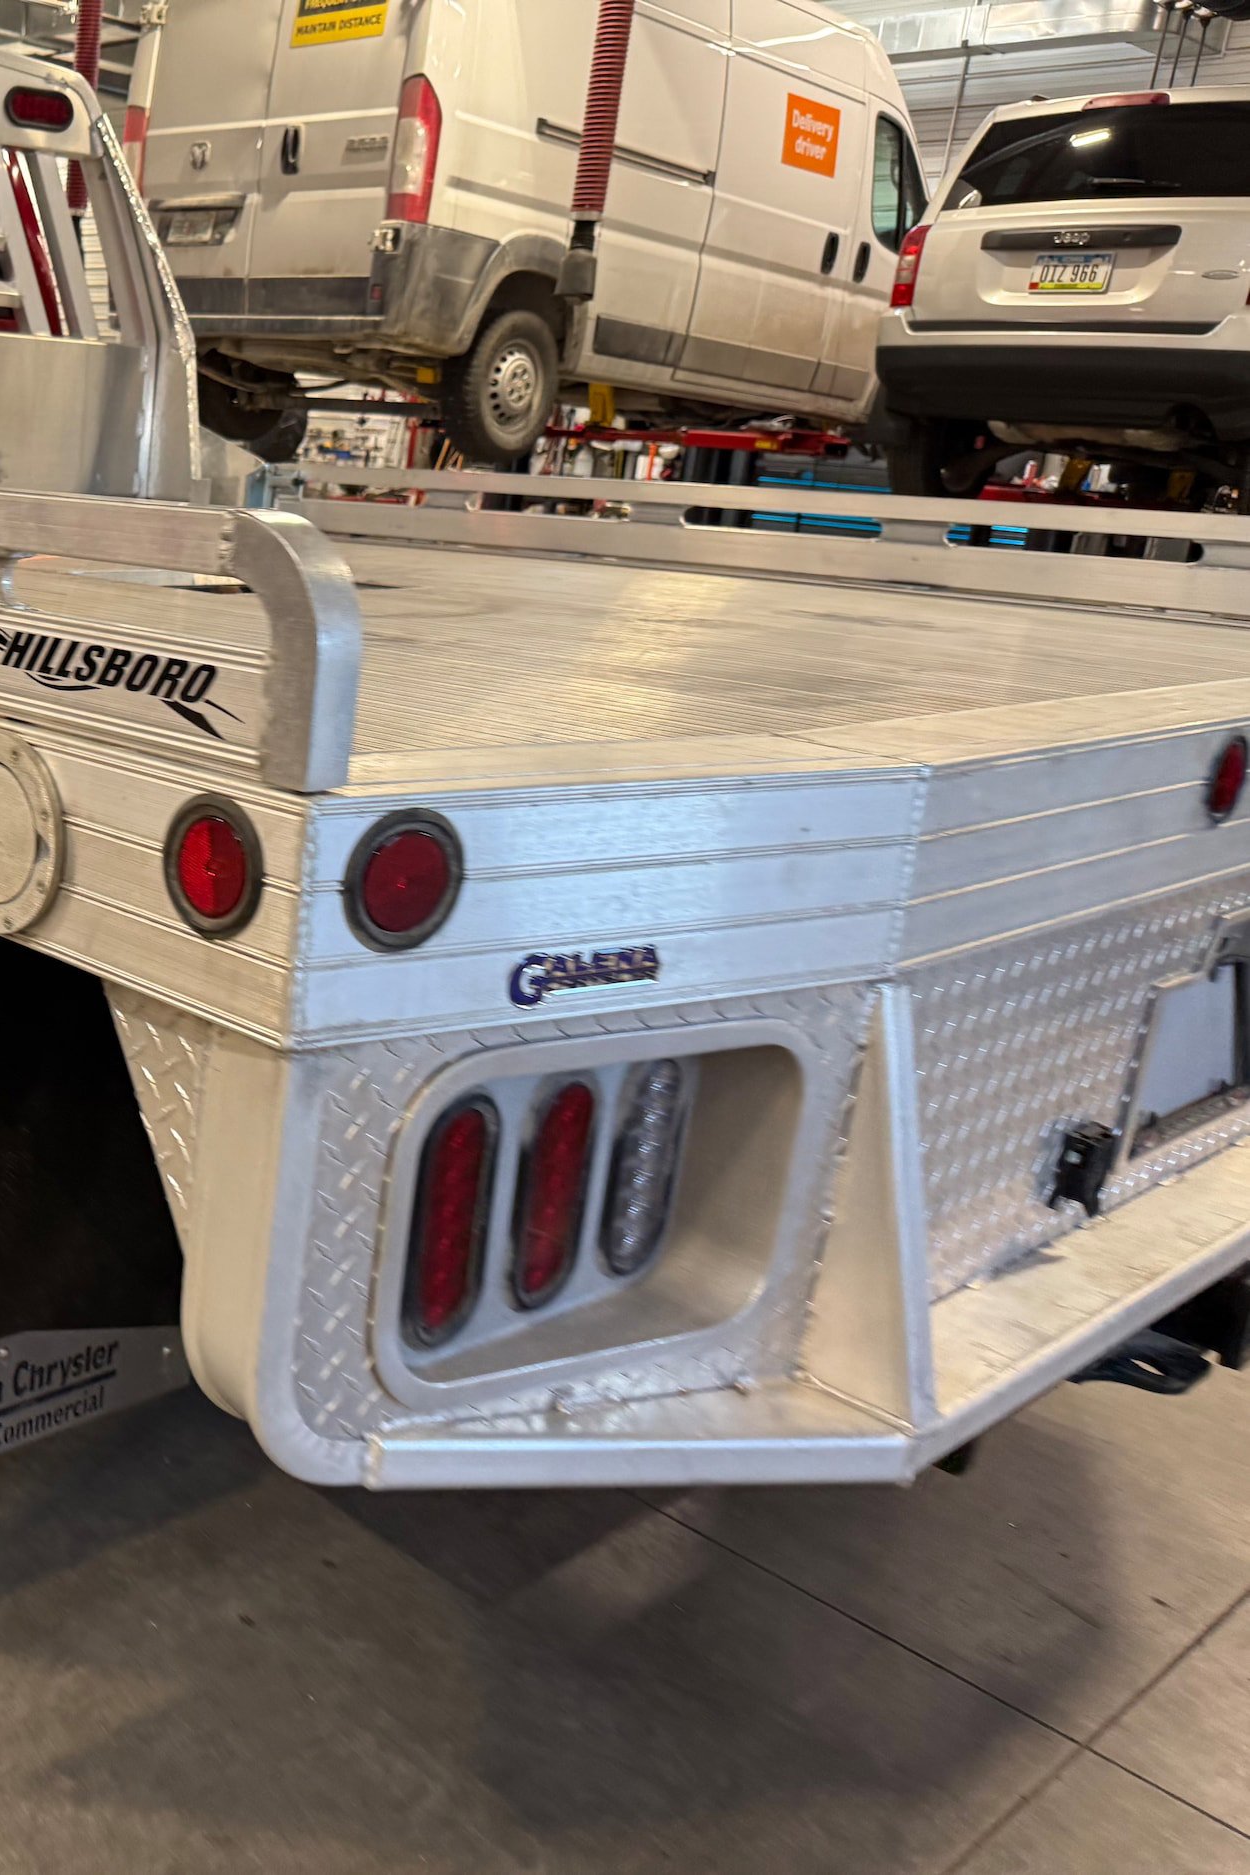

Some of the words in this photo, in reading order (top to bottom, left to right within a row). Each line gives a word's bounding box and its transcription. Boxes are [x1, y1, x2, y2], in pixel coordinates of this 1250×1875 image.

[295, 21, 337, 36] MAINTAIN
[338, 13, 382, 30] DISTANCE
[792, 108, 834, 143] Delivery
[795, 135, 827, 160] driver
[1054, 231, 1090, 246] Jeep
[1070, 263, 1099, 283] 966
[1, 631, 219, 703] HILLSBORO
[14, 1341, 119, 1397] Chrysler
